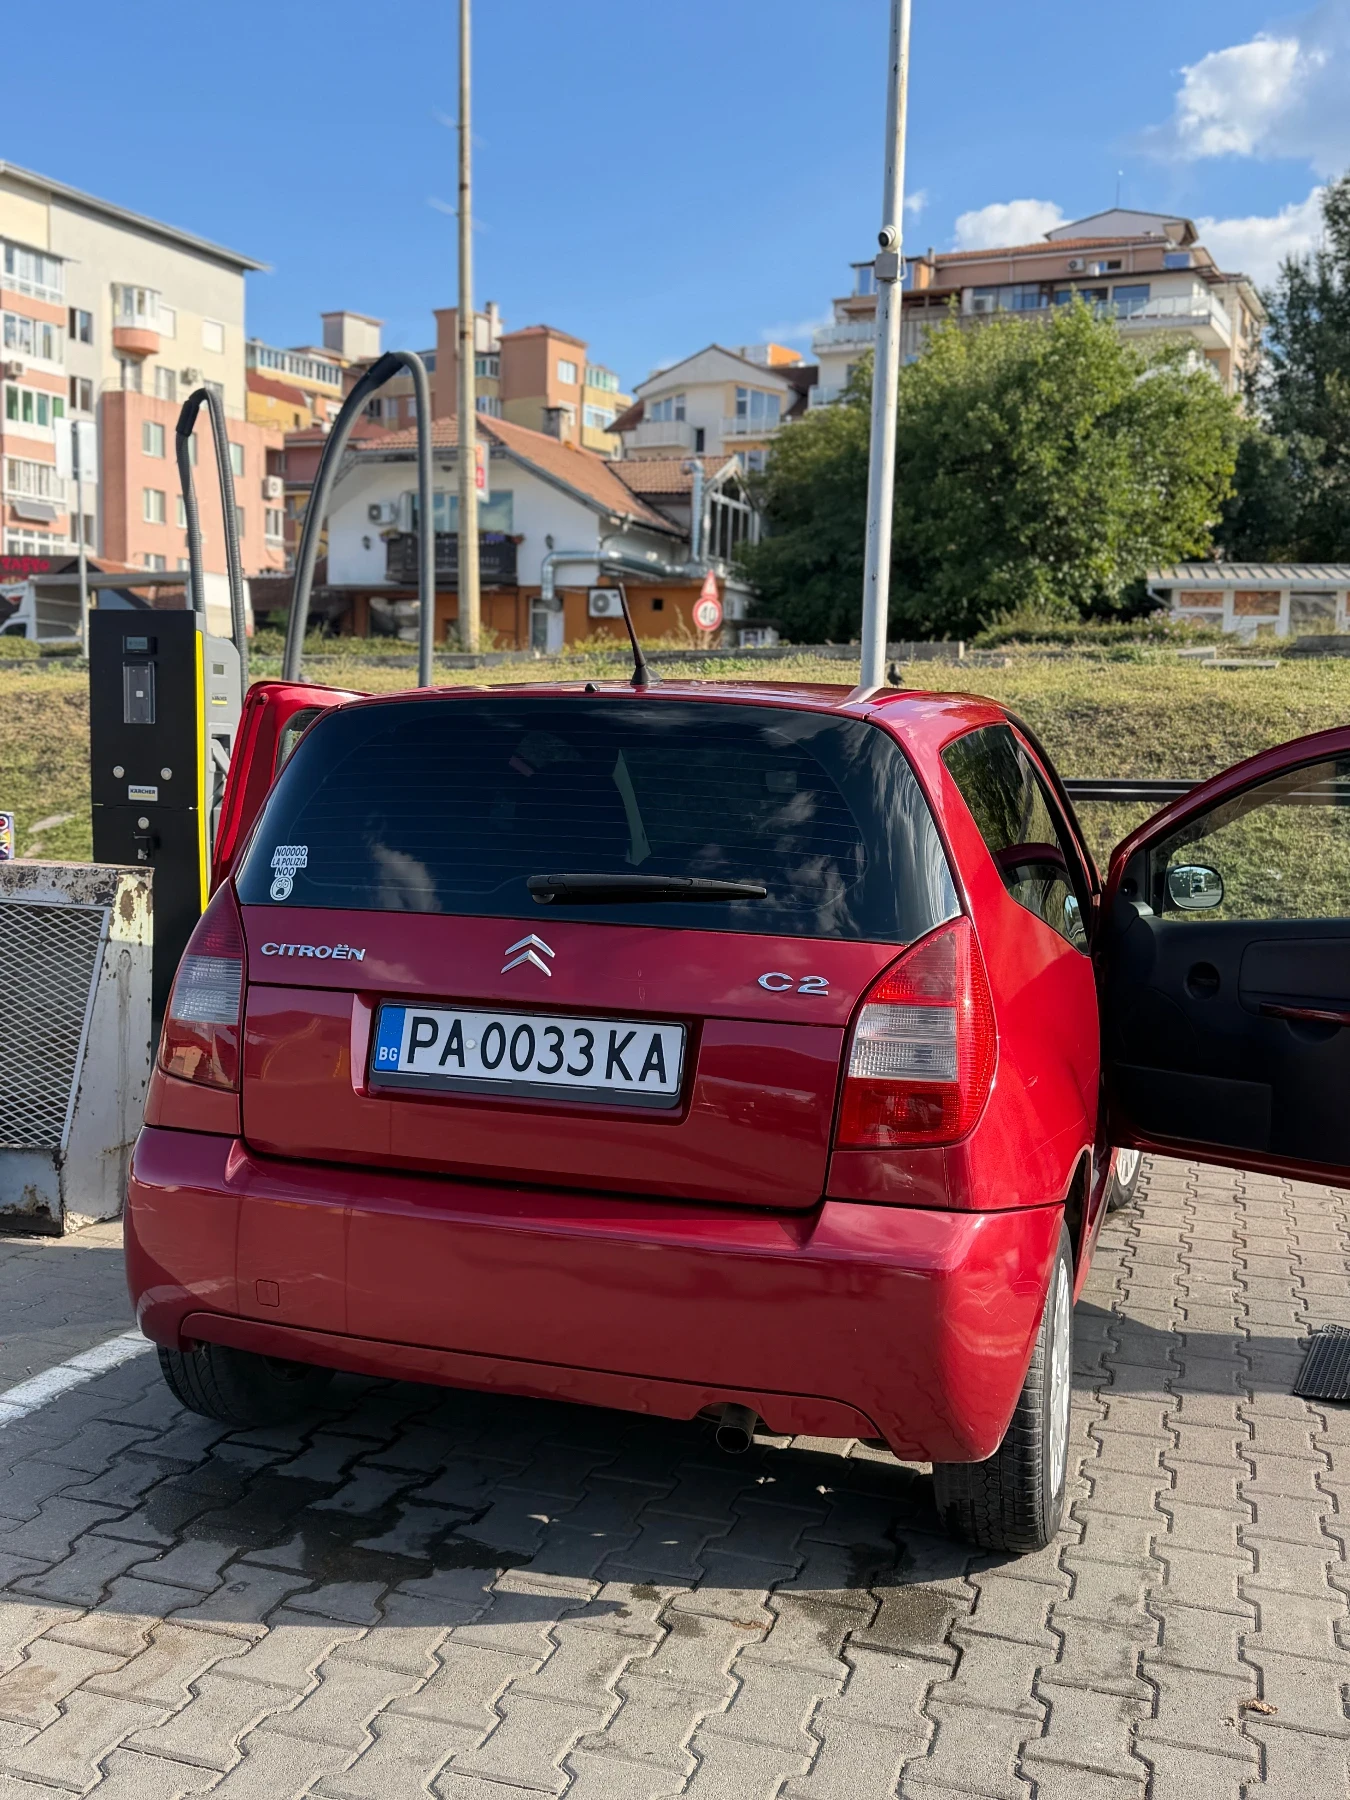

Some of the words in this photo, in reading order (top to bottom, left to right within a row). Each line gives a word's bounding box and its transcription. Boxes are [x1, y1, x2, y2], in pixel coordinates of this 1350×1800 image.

[700, 604, 717, 623] 40
[275, 847, 307, 857] NOOOOO
[272, 857, 280, 866] LA
[281, 857, 306, 867] POLIZIA
[275, 866, 295, 877] NOO
[261, 942, 366, 962] CITROËN
[757, 971, 830, 996] C2
[378, 1046, 398, 1062] BG
